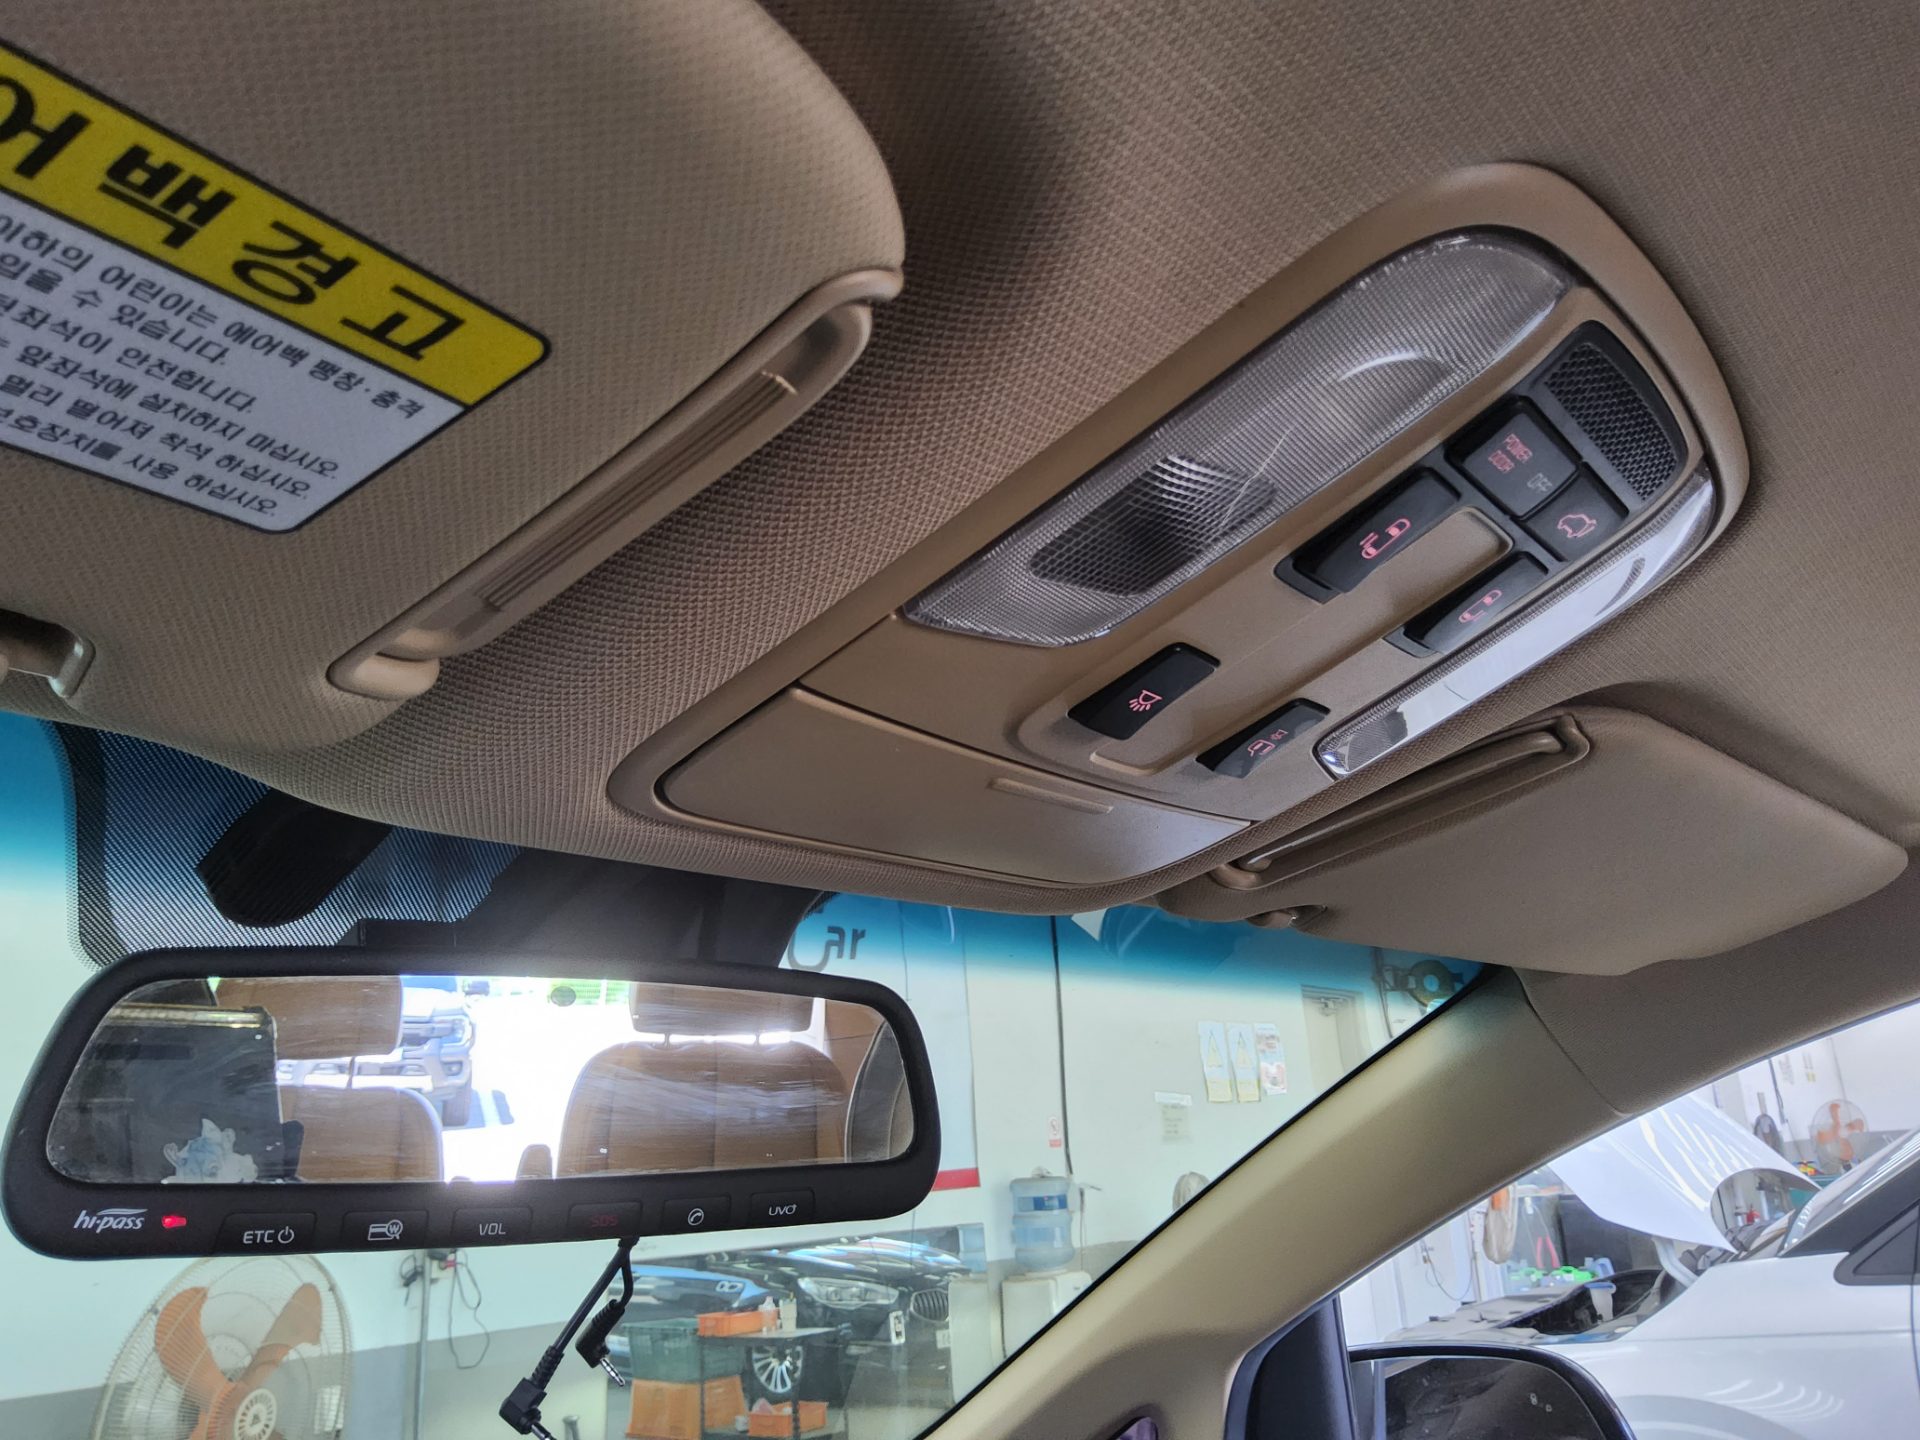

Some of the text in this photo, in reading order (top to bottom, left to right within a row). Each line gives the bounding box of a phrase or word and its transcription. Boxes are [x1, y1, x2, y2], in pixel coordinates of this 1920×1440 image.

[72, 289, 103, 309] 수
[109, 304, 230, 366] 있습니다.
[99, 265, 219, 329] 어린이는
[223, 321, 310, 368] 에어백
[116, 347, 257, 414] 안전합니다.
[15, 345, 339, 480] 앞좌석에 설치하지 마십시오.
[0, 374, 311, 499] 멀리 떨어져 착석 하십시오.
[1503, 433, 1533, 464] POWER
[122, 454, 179, 480] 사용
[184, 473, 278, 517] 하십시오.
[1527, 473, 1553, 492] OFF
[73, 1208, 147, 1233] hi-pass
[591, 1214, 618, 1228] SOS
[768, 1203, 798, 1216] UVO
[243, 1230, 275, 1244] ETC
[479, 1223, 506, 1236] VOL
